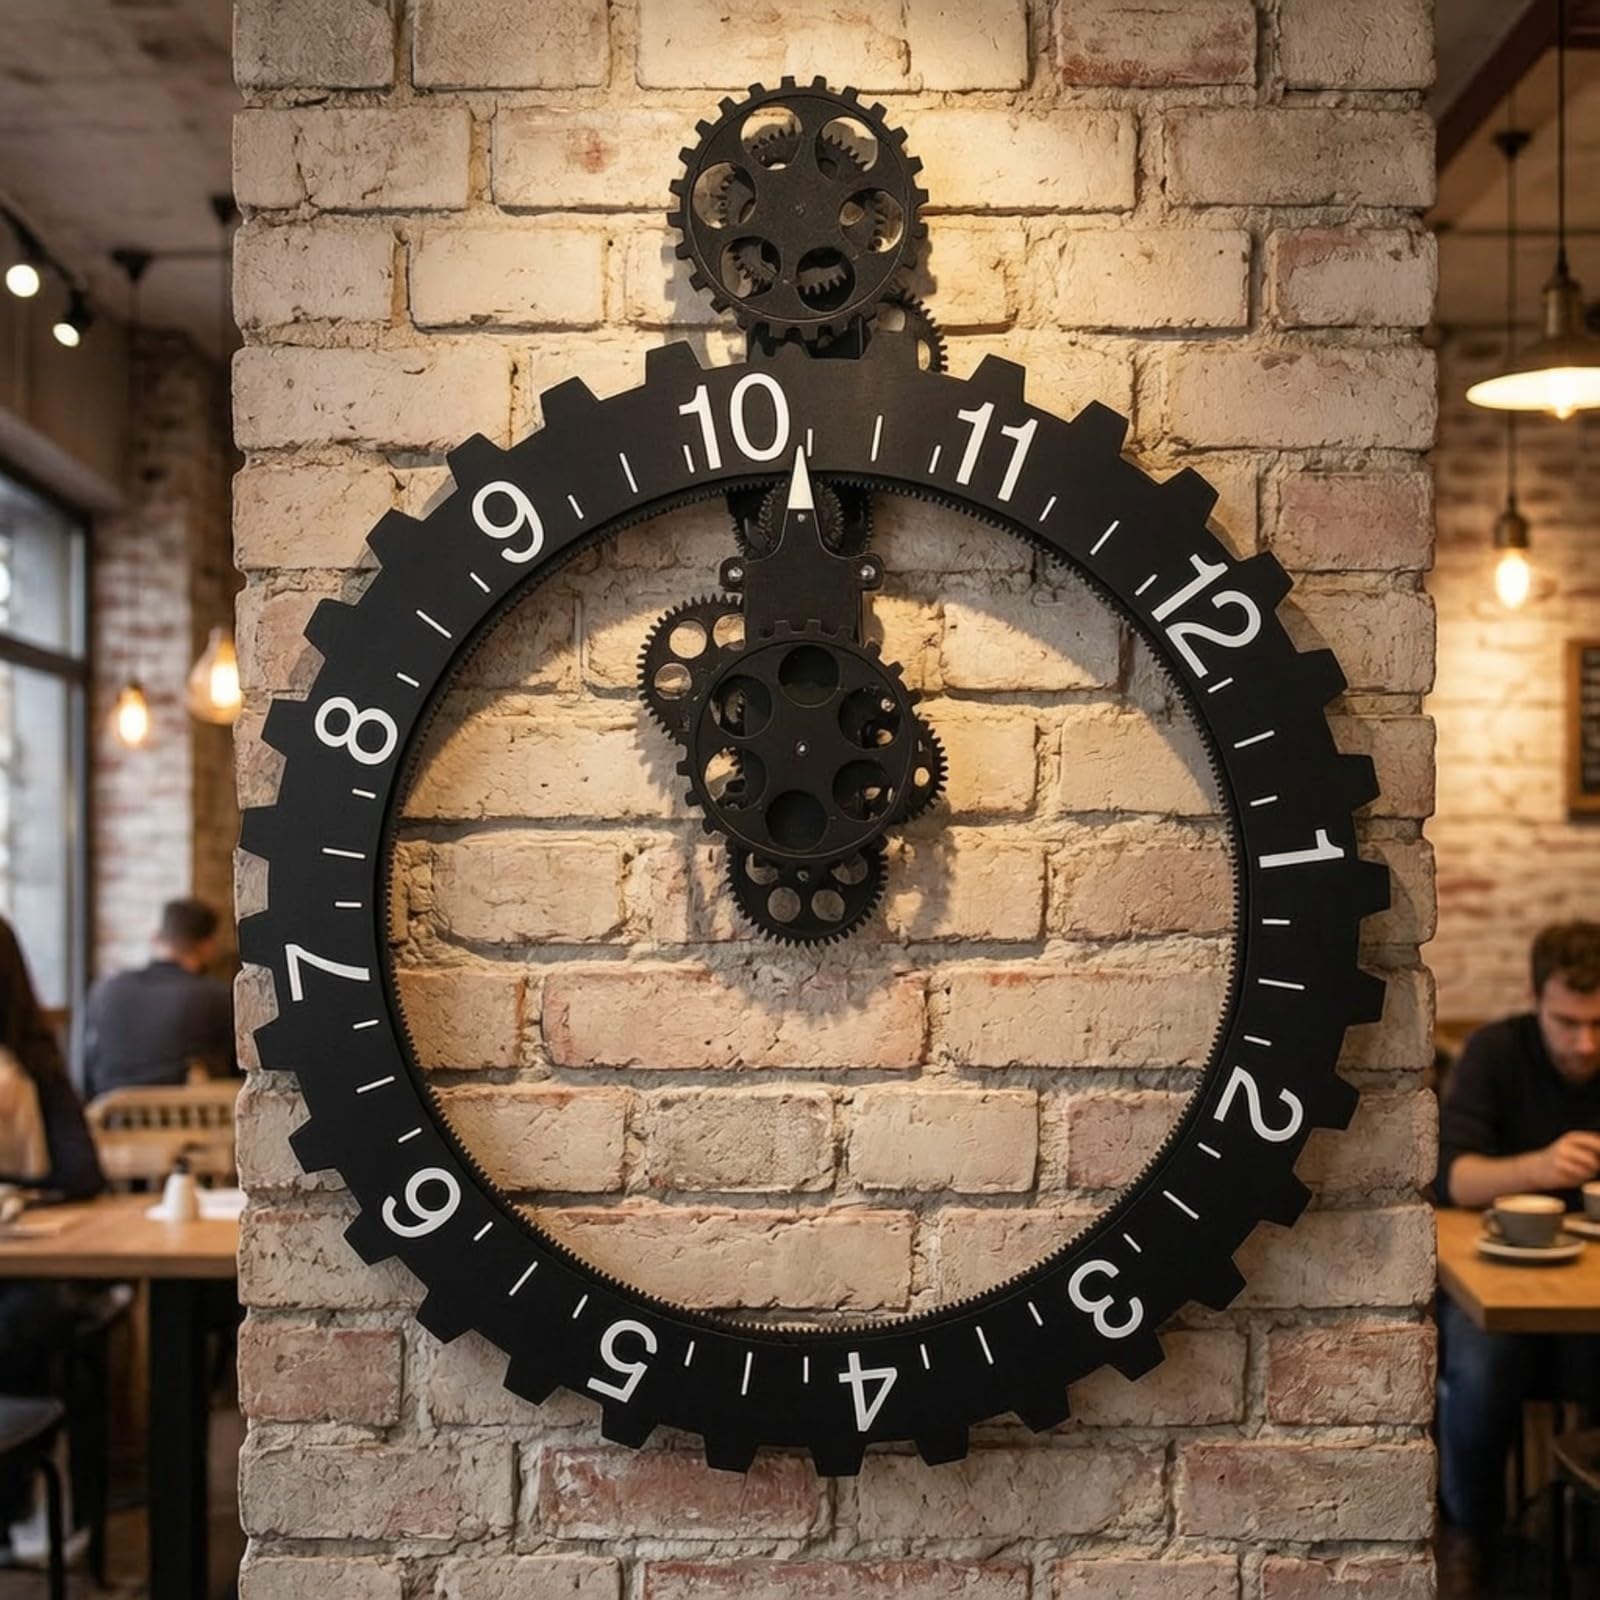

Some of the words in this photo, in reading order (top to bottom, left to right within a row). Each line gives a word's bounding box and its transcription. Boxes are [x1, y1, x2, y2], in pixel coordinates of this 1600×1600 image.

[678, 372, 790, 470] 10
[956, 401, 1038, 502] 11
[471, 480, 544, 564] 9
[1151, 553, 1261, 678] 12
[314, 696, 398, 765] 8
[1258, 829, 1345, 868] 1
[284, 943, 370, 1002] 7
[1213, 1066, 1303, 1142] 2
[381, 1167, 461, 1238] 6
[1067, 1258, 1144, 1339] 3
[587, 1319, 658, 1403] 5
[838, 1351, 898, 1432] 4
